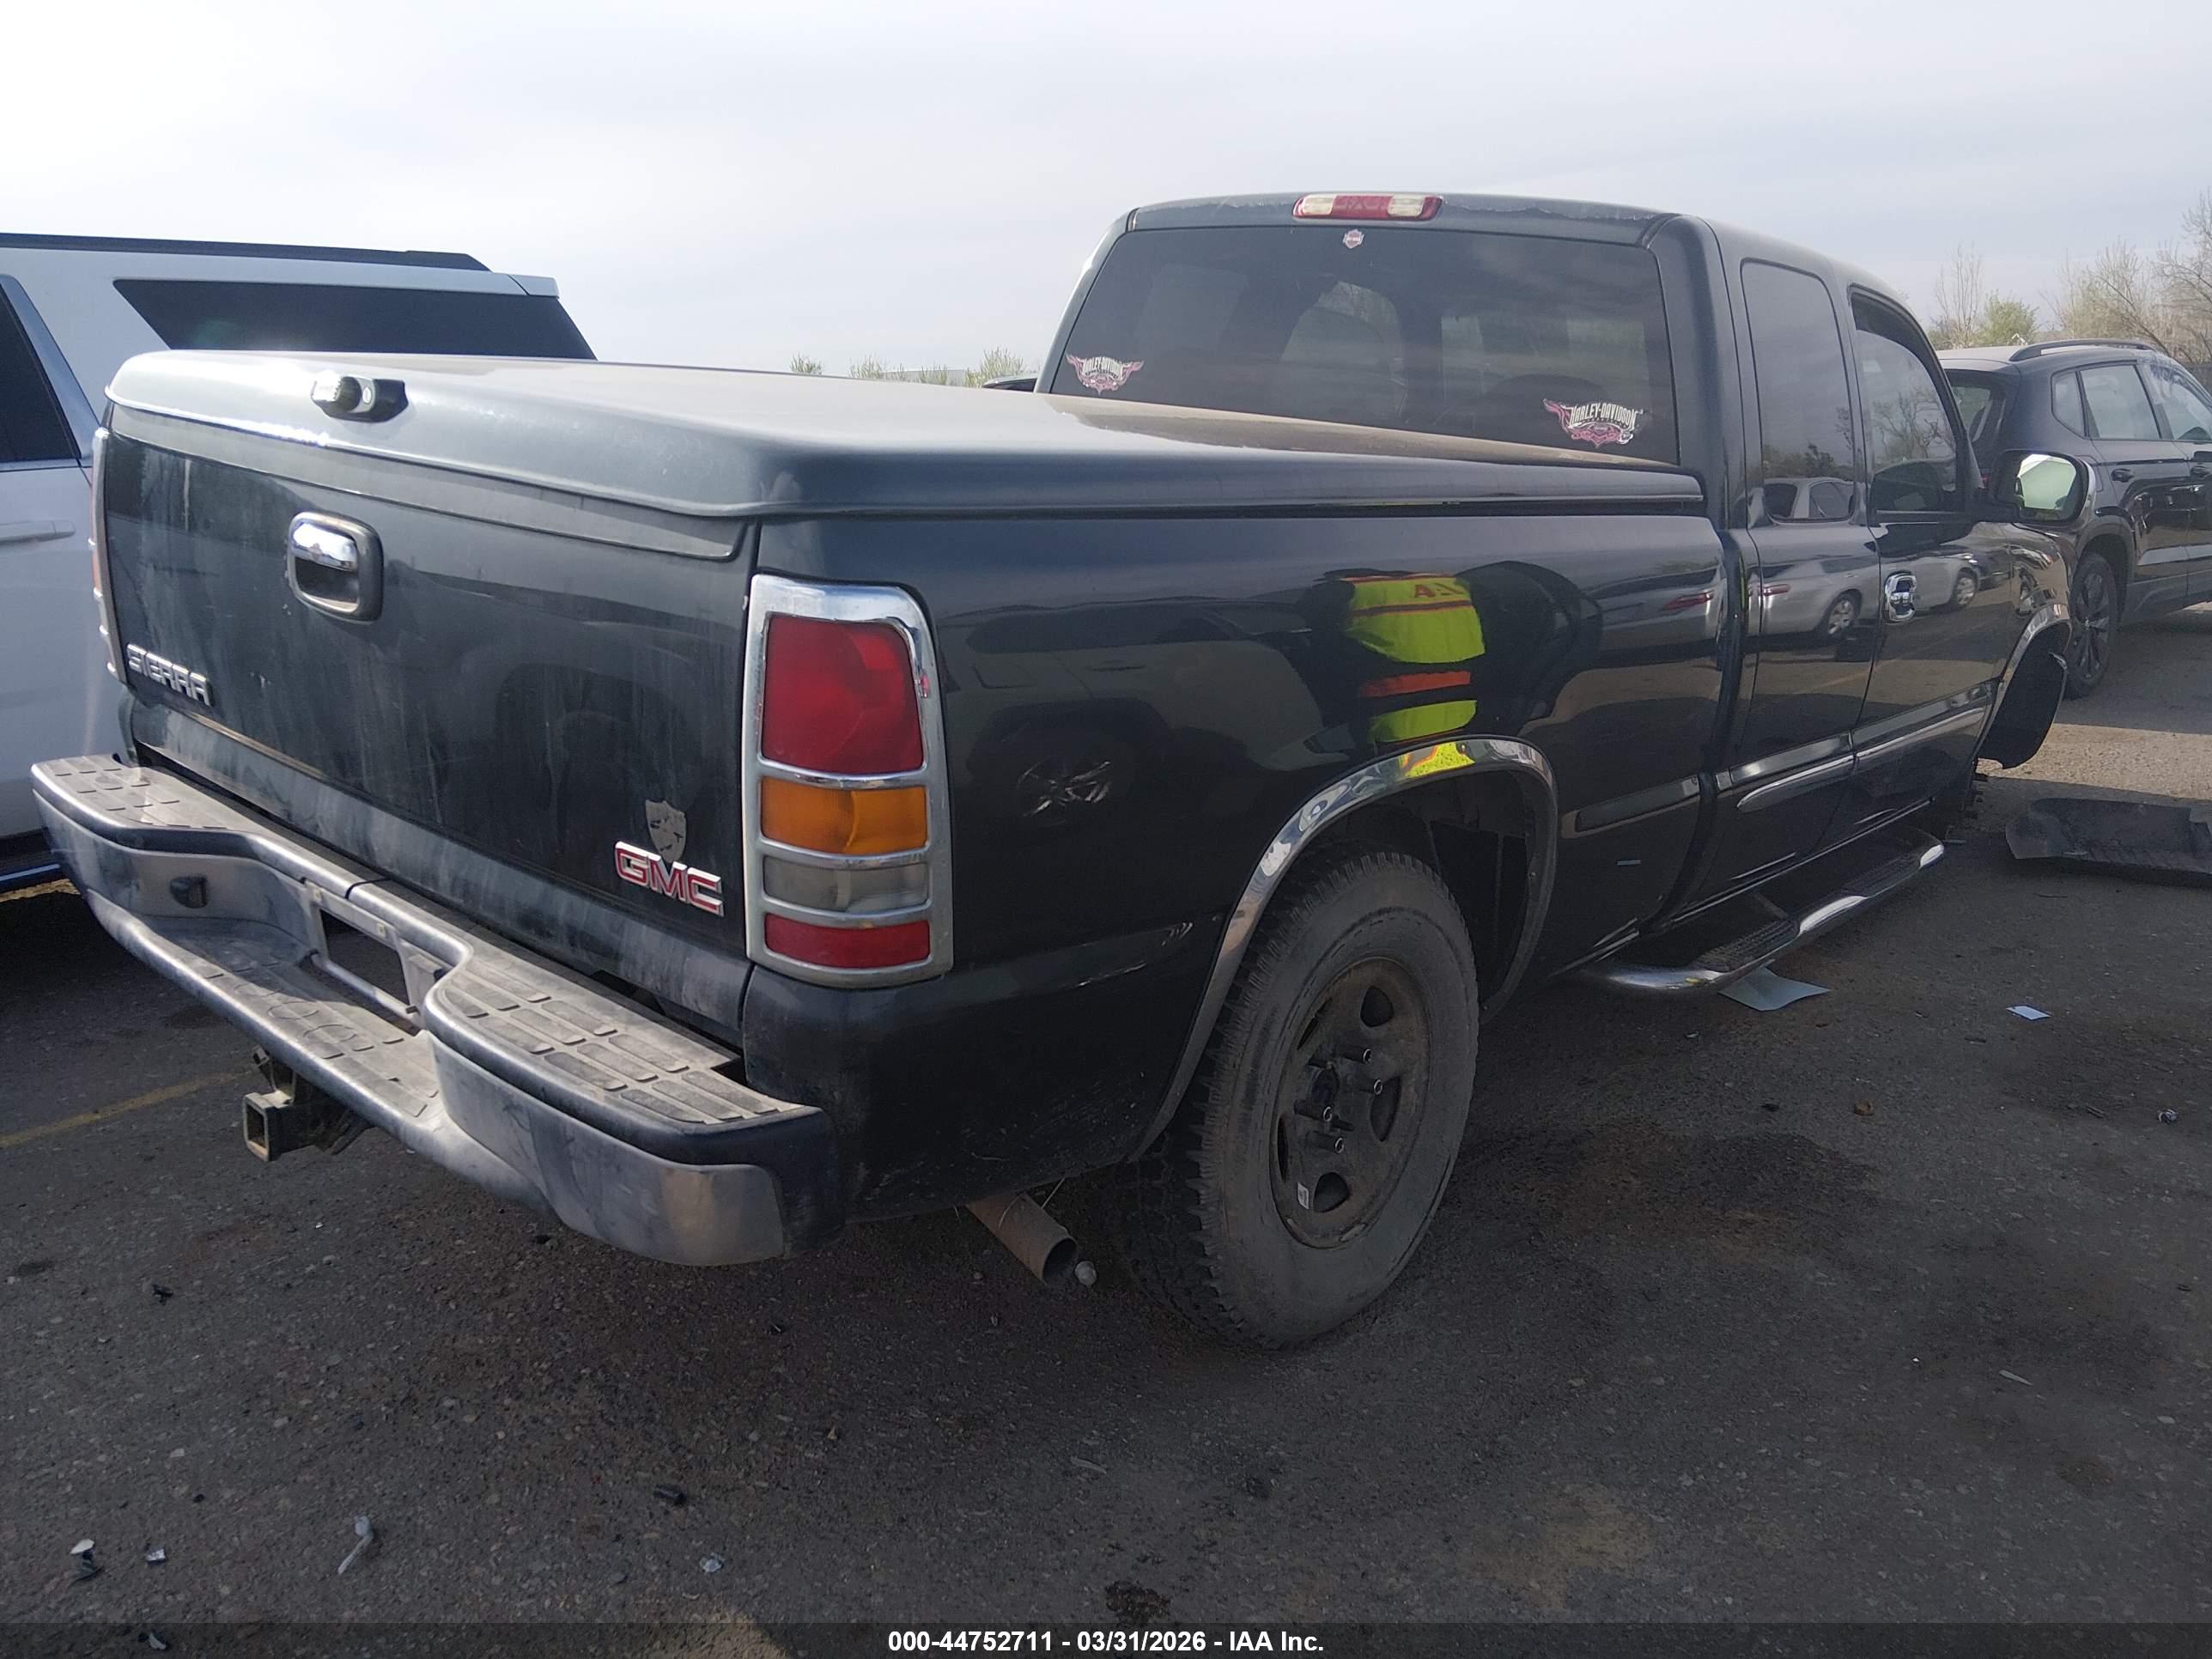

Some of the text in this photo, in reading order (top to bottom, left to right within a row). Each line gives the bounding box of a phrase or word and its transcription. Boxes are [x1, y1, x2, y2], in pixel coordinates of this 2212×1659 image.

[1571, 402, 1637, 428] HARLEY-DAVIDSON
[127, 644, 210, 706] SIERRA
[615, 842, 724, 917] GMC
